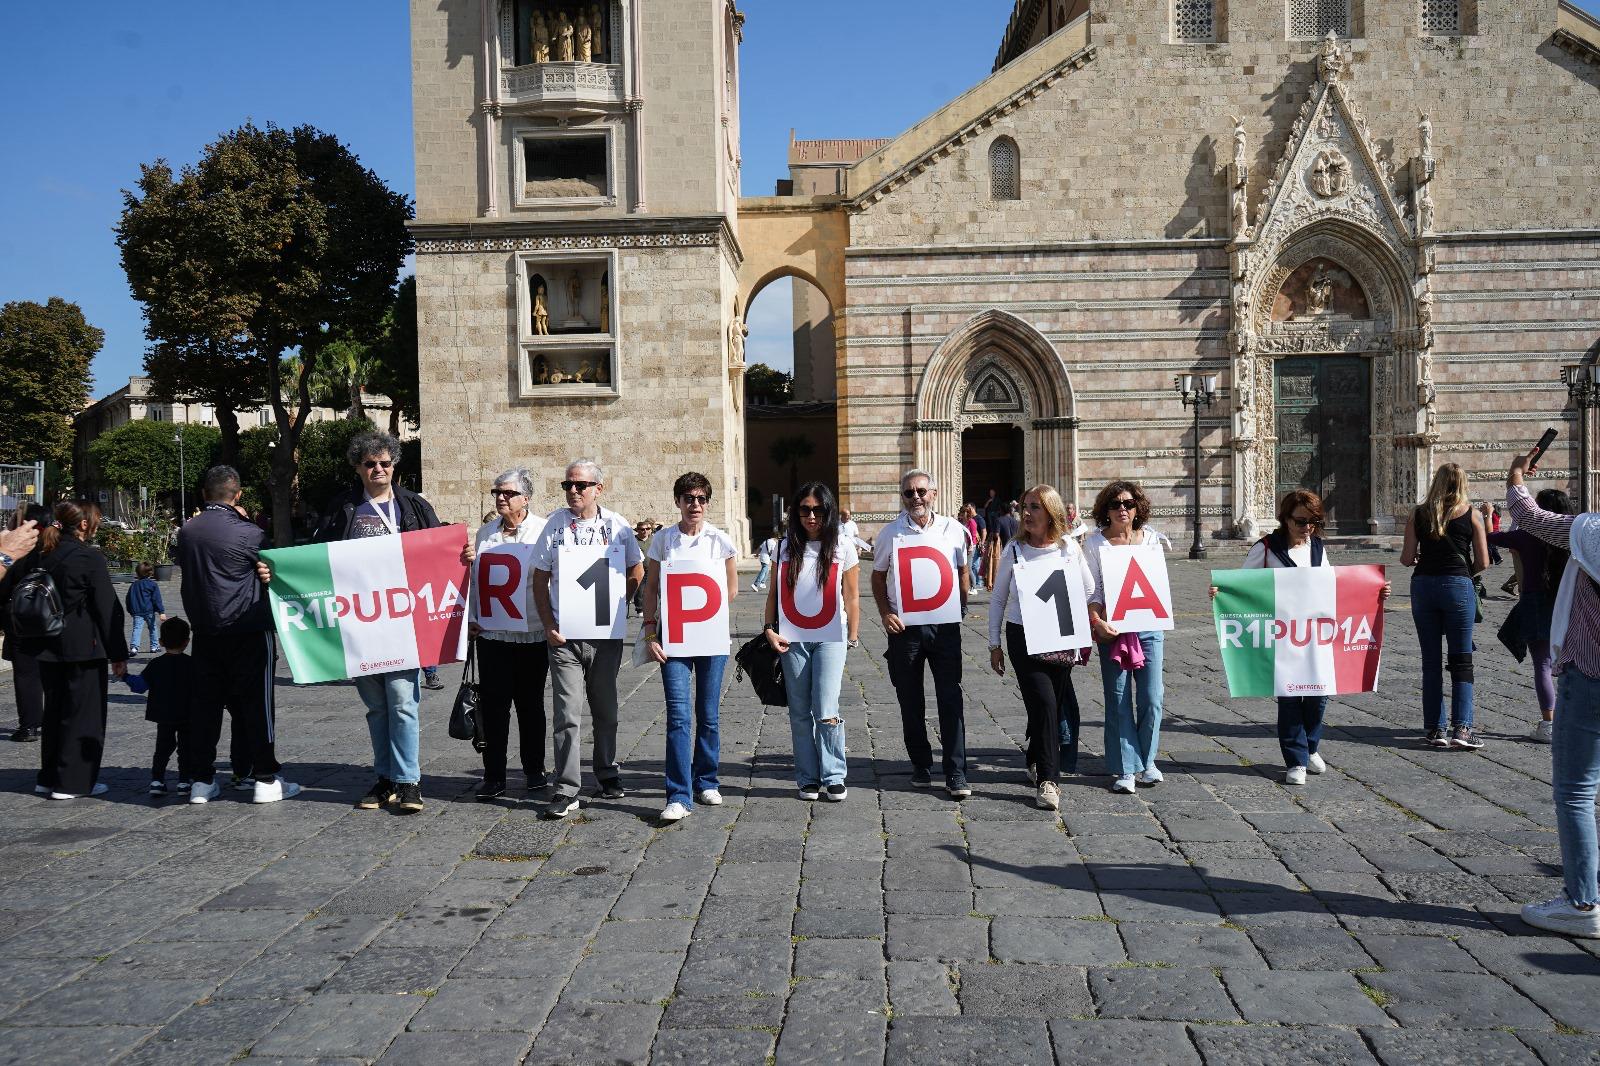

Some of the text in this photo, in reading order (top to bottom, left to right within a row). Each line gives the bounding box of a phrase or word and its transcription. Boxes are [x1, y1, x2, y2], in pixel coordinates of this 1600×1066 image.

[279, 579, 466, 632] R1PUD1A
[478, 553, 523, 619] R
[576, 558, 610, 627] 1
[666, 573, 722, 644] P
[781, 562, 839, 629] U
[898, 546, 953, 613] D
[1035, 569, 1075, 637] 1
[1111, 556, 1169, 622] A
[1219, 615, 1377, 649] R1PUD1A
